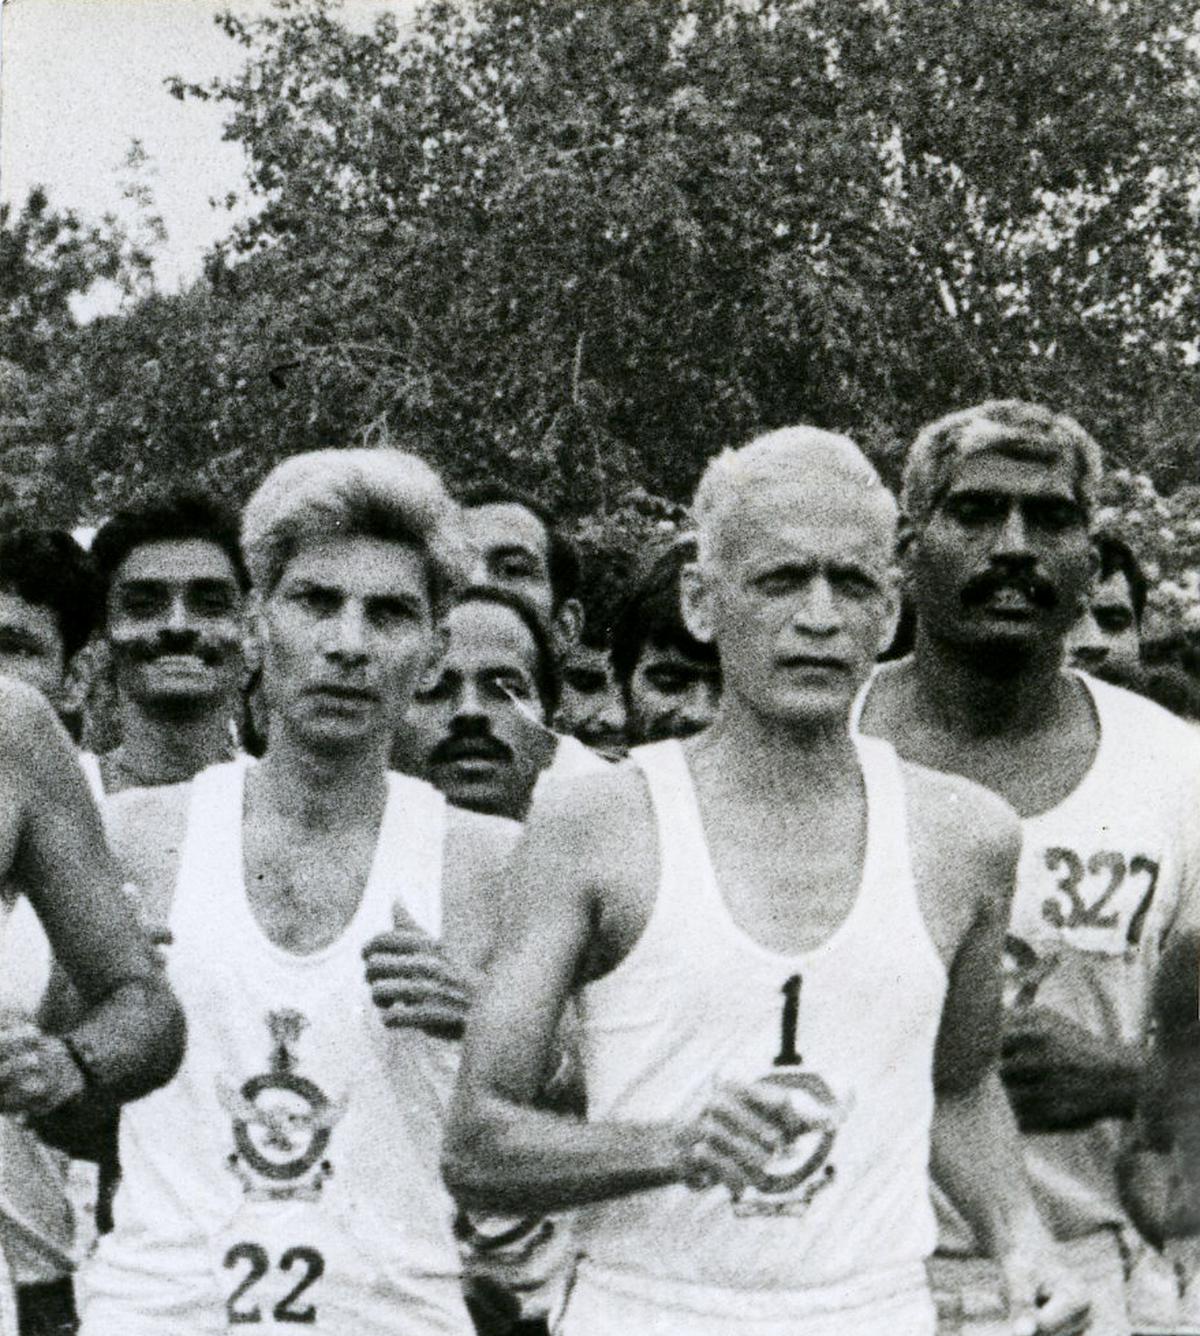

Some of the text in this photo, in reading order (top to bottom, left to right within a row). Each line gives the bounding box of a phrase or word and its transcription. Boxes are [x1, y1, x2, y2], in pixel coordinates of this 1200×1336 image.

[1042, 847, 1160, 945] 327
[773, 974, 803, 1066] 1
[223, 1243, 325, 1324] 22
